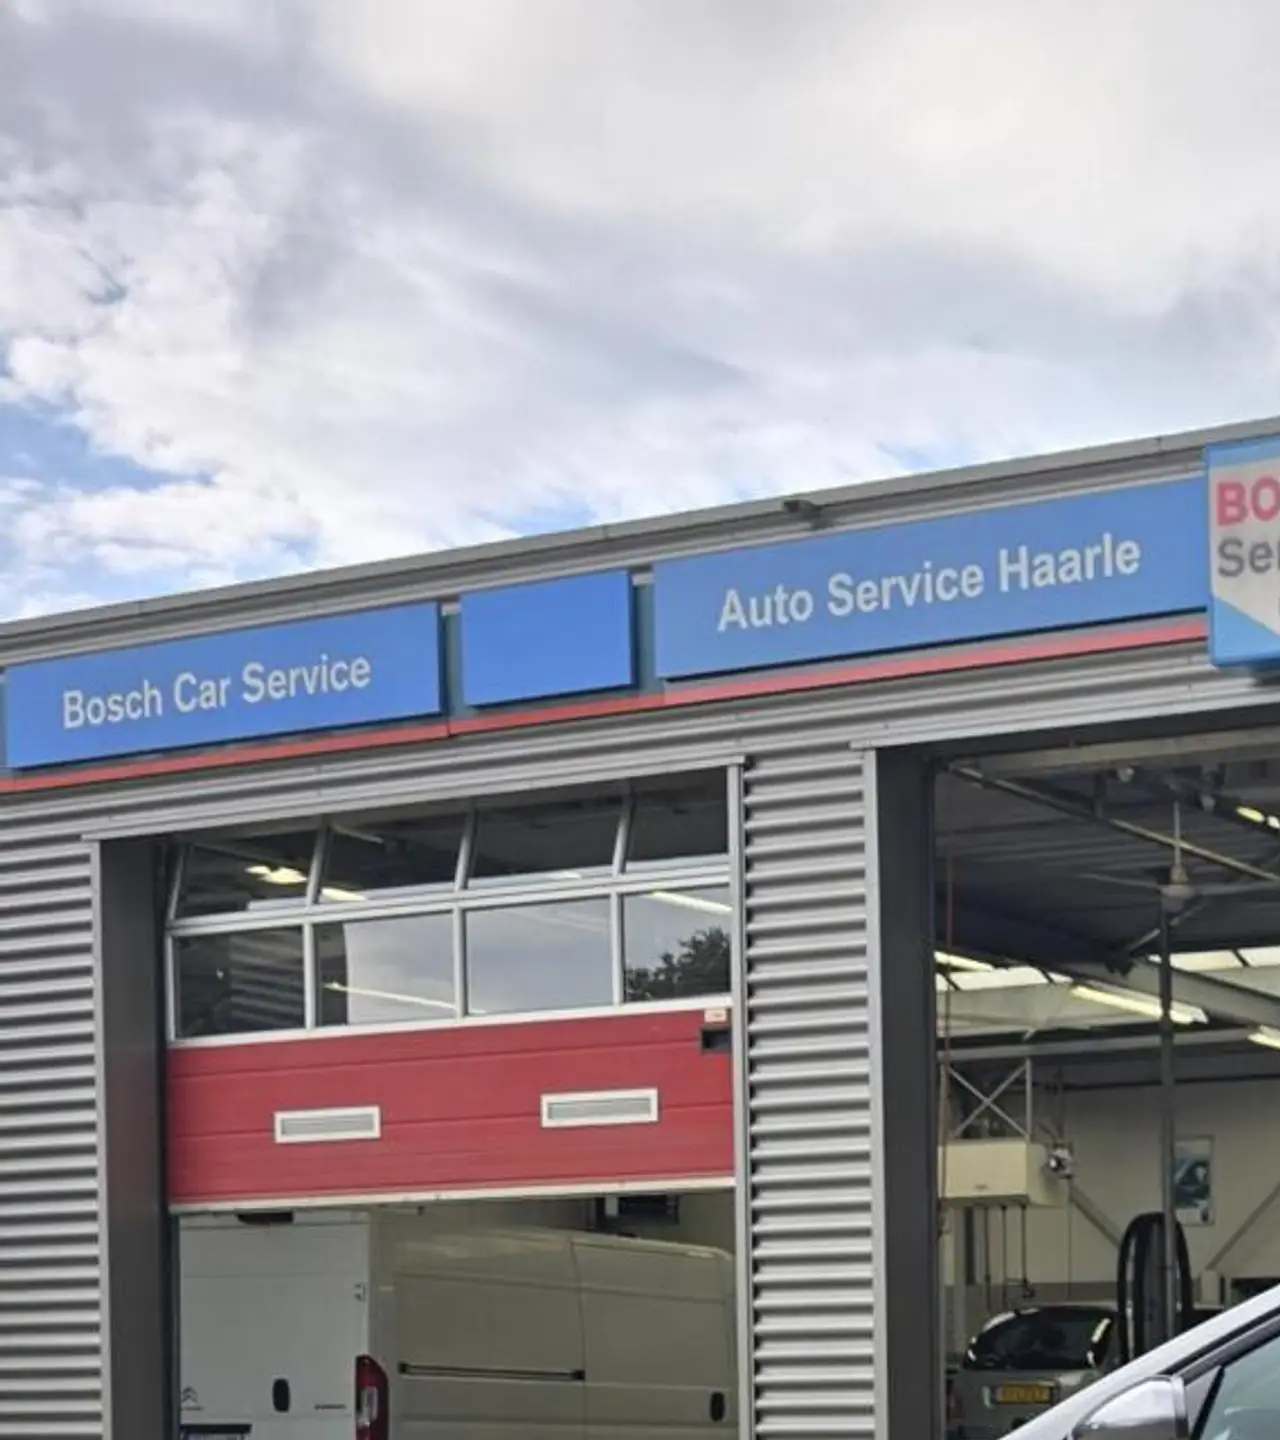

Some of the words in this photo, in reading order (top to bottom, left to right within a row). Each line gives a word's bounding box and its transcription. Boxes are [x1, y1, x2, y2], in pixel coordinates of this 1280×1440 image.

[717, 586, 813, 632] Auto
[827, 560, 985, 616] Service
[1000, 533, 1141, 592] Haarle
[63, 680, 163, 729] Bosch
[174, 672, 230, 713] Car
[241, 654, 370, 703] Service
